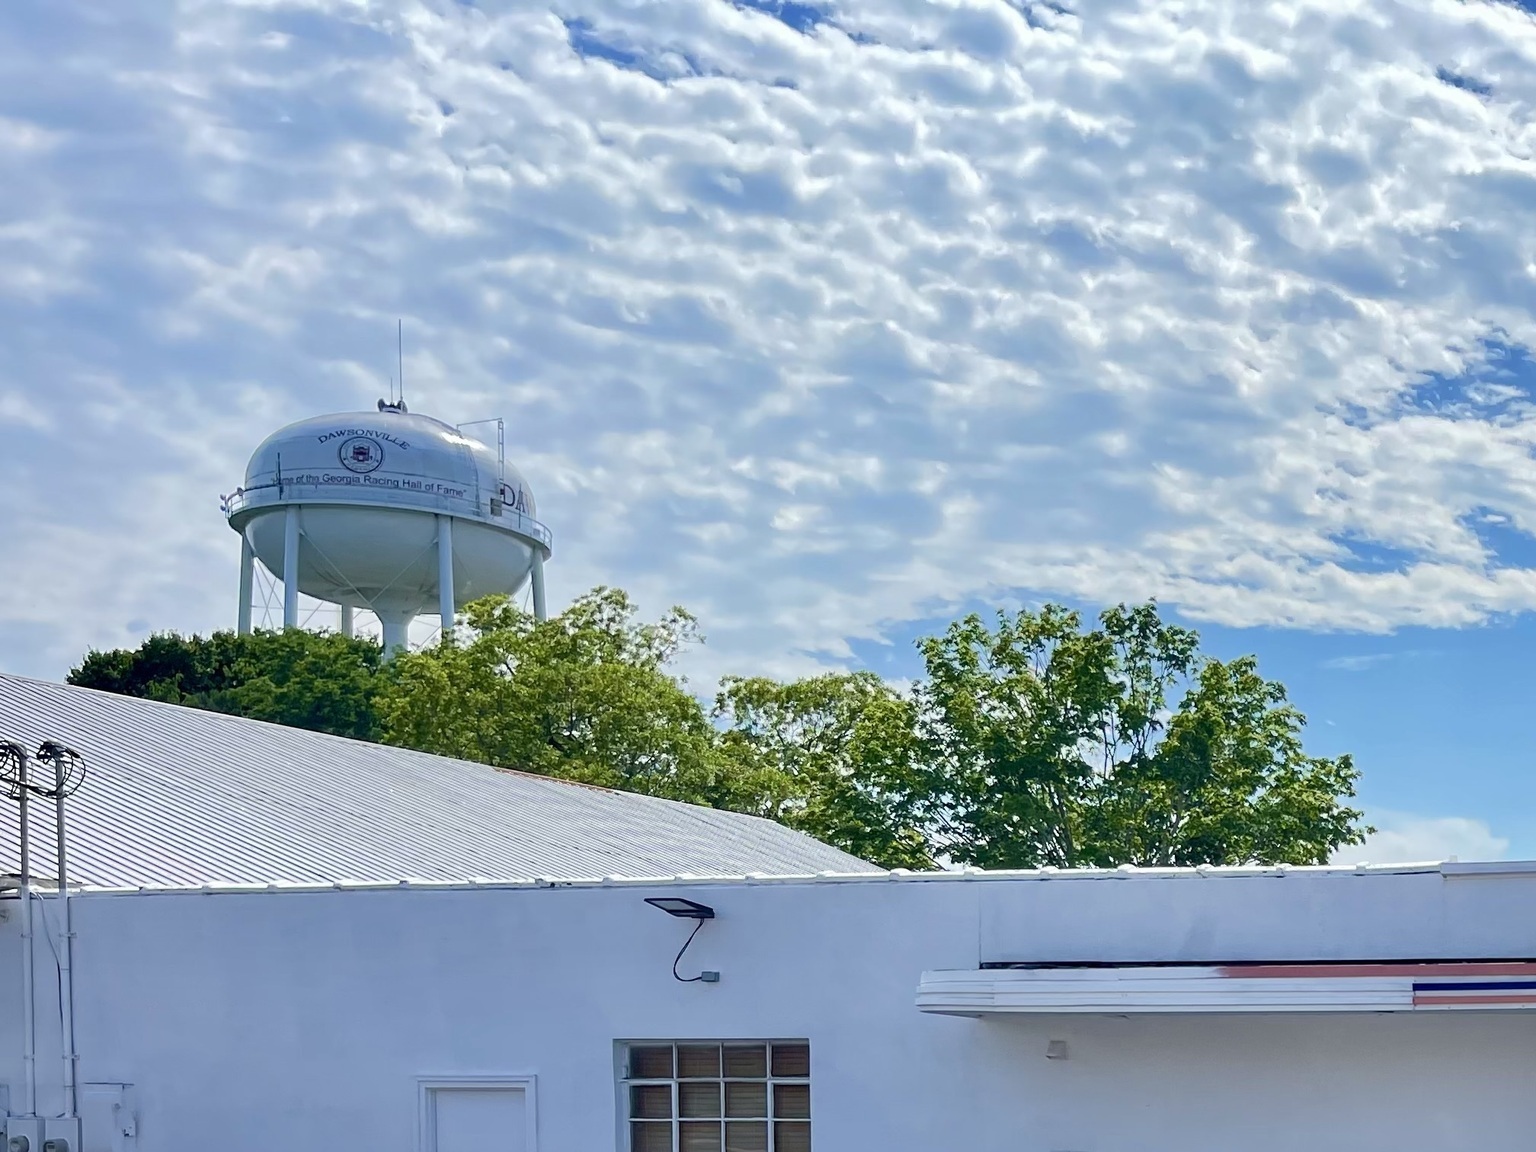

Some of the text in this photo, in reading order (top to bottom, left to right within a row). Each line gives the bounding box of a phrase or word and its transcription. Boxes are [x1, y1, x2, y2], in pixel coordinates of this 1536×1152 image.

[317, 428, 411, 451] DAWSONVILLE
[322, 473, 361, 485] Georgia
[363, 475, 400, 489] Racing
[402, 478, 422, 490] Hall
[424, 483, 435, 492] of
